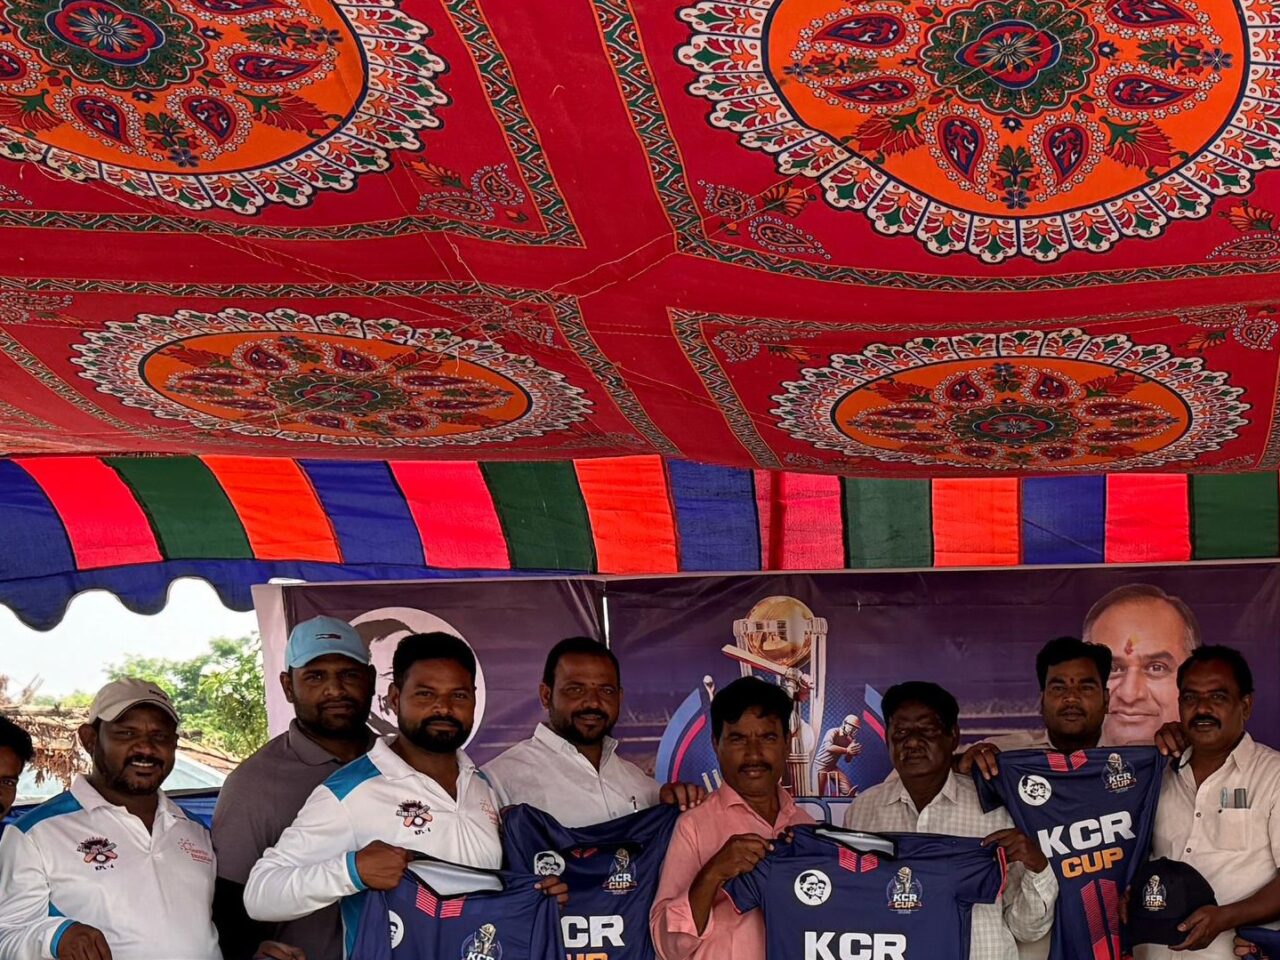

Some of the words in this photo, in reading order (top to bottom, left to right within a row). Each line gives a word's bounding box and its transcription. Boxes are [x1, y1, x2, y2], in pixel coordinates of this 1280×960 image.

[1108, 772, 1132, 784] KCR
[1111, 780, 1131, 789] CUP
[1037, 810, 1136, 858] KCR
[1061, 847, 1124, 879] CUP
[893, 893, 918, 902] KCR
[561, 915, 625, 948] CR
